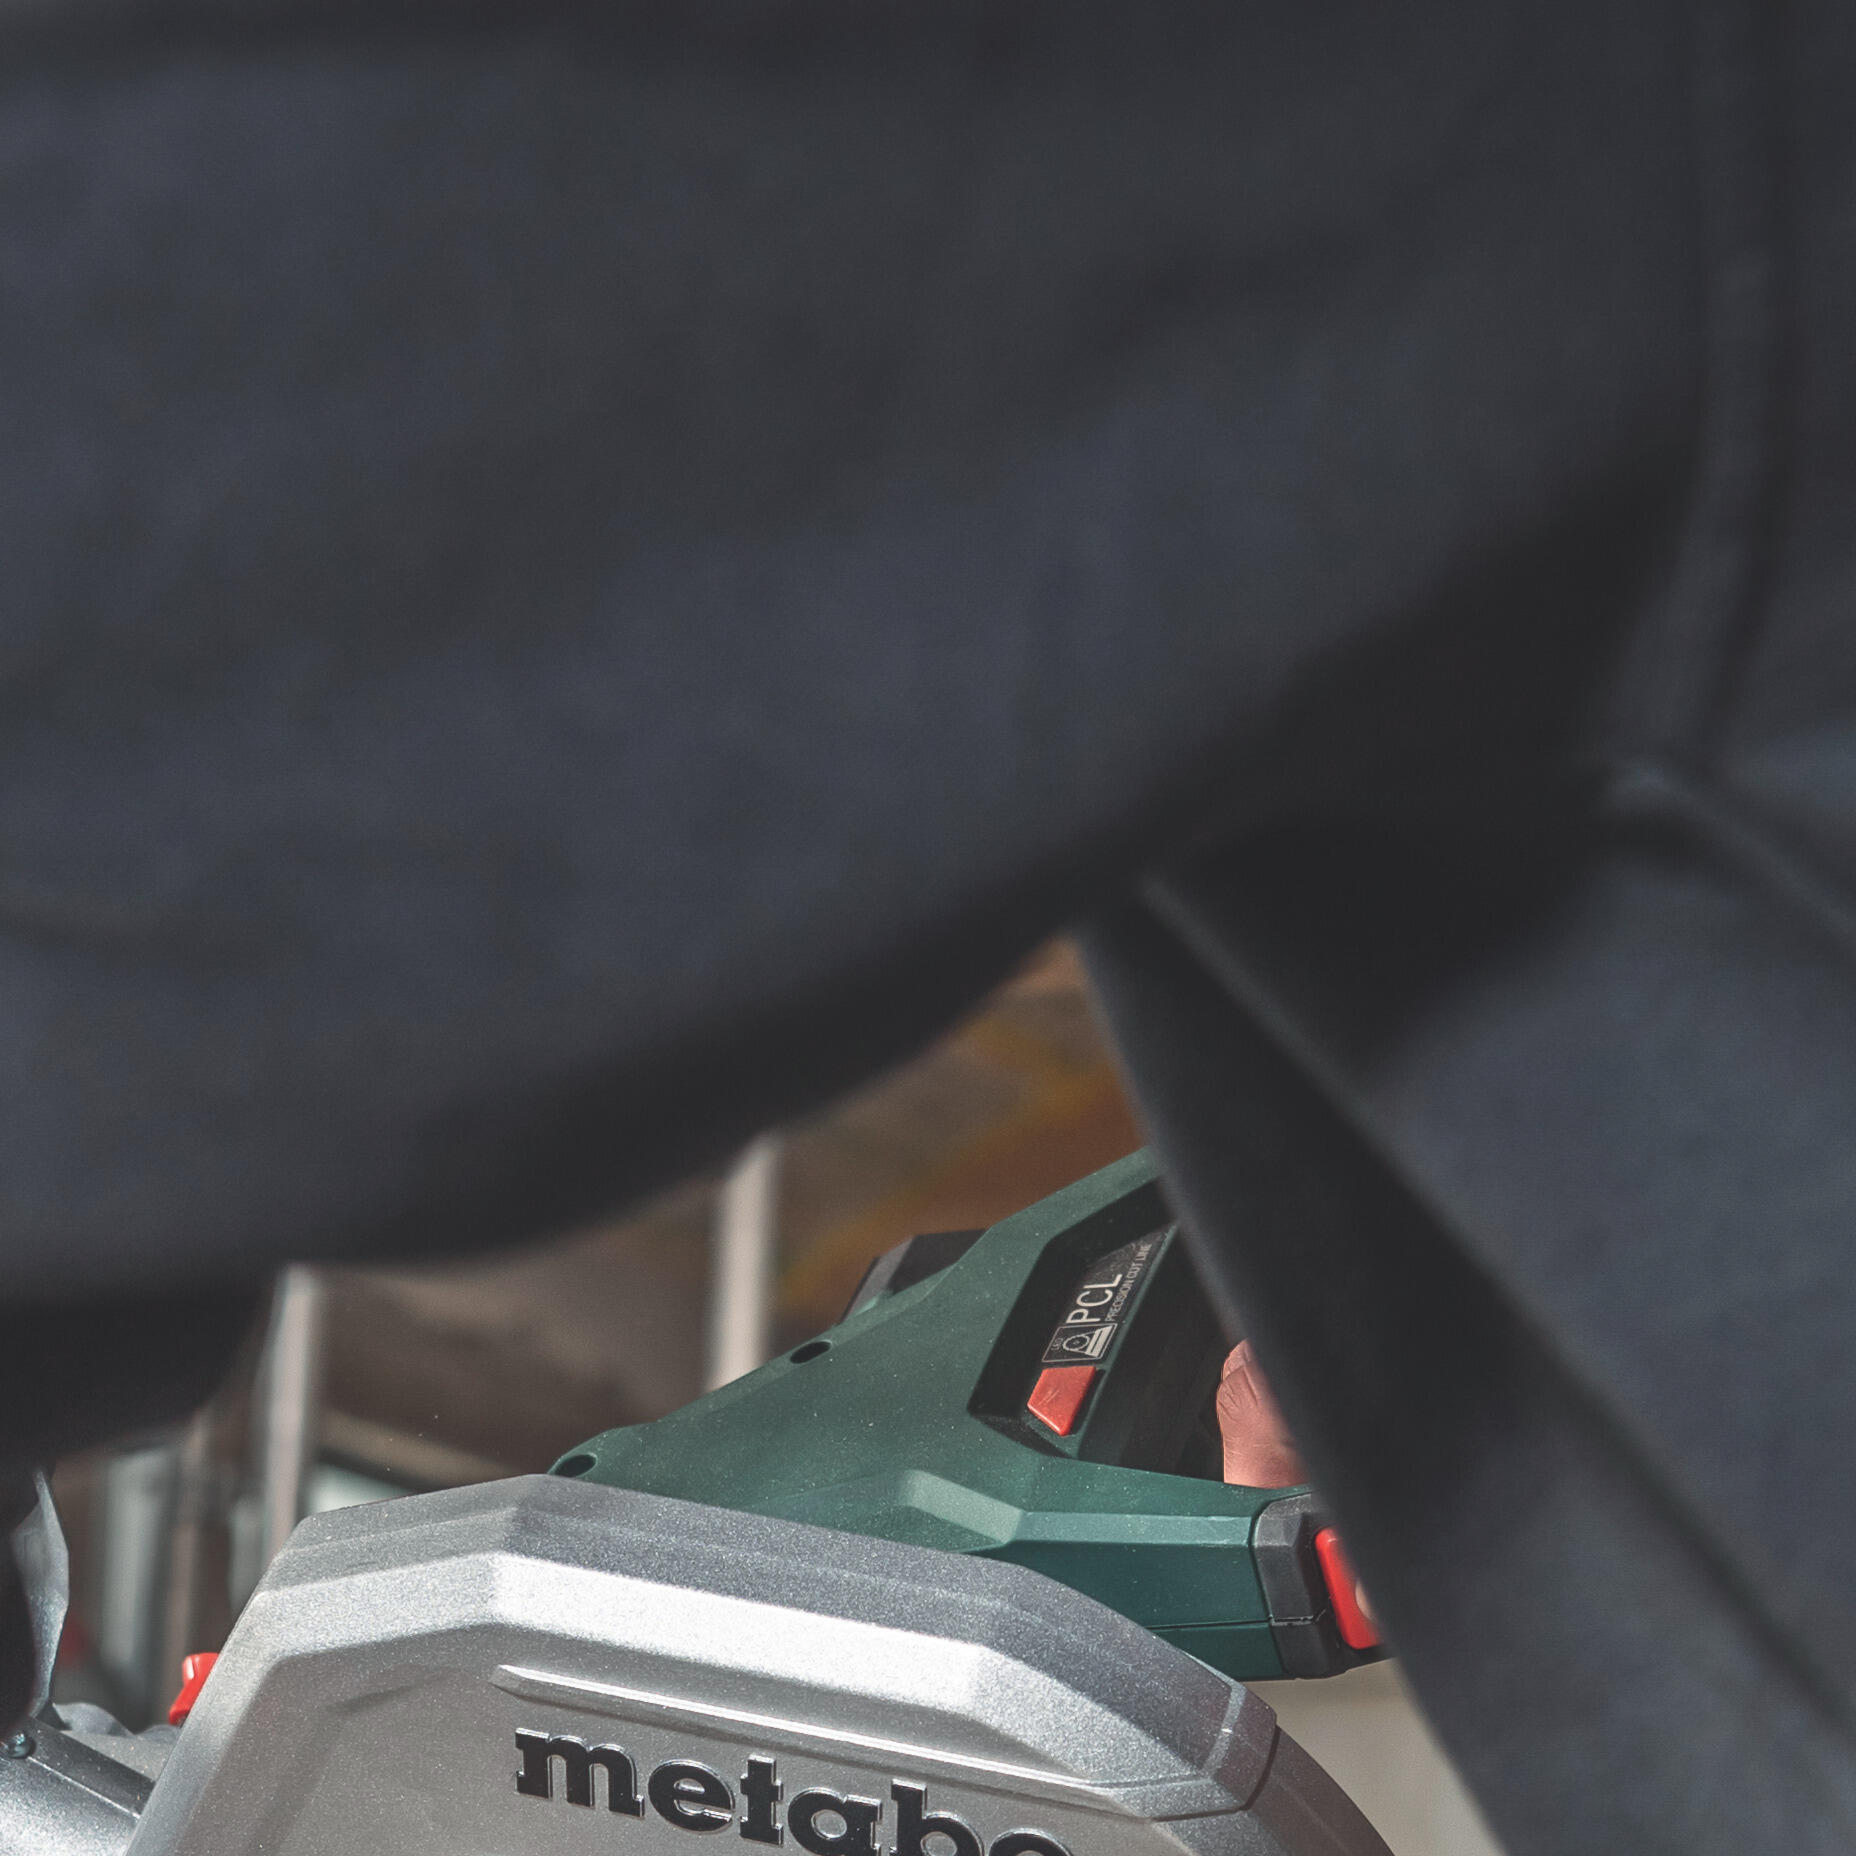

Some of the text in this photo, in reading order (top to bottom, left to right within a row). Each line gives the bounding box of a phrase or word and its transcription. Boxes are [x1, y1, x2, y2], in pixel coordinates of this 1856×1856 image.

[1066, 1274, 1122, 1323] PCL
[1105, 1280, 1135, 1321] PRECISION
[1126, 1263, 1143, 1279] CUT
